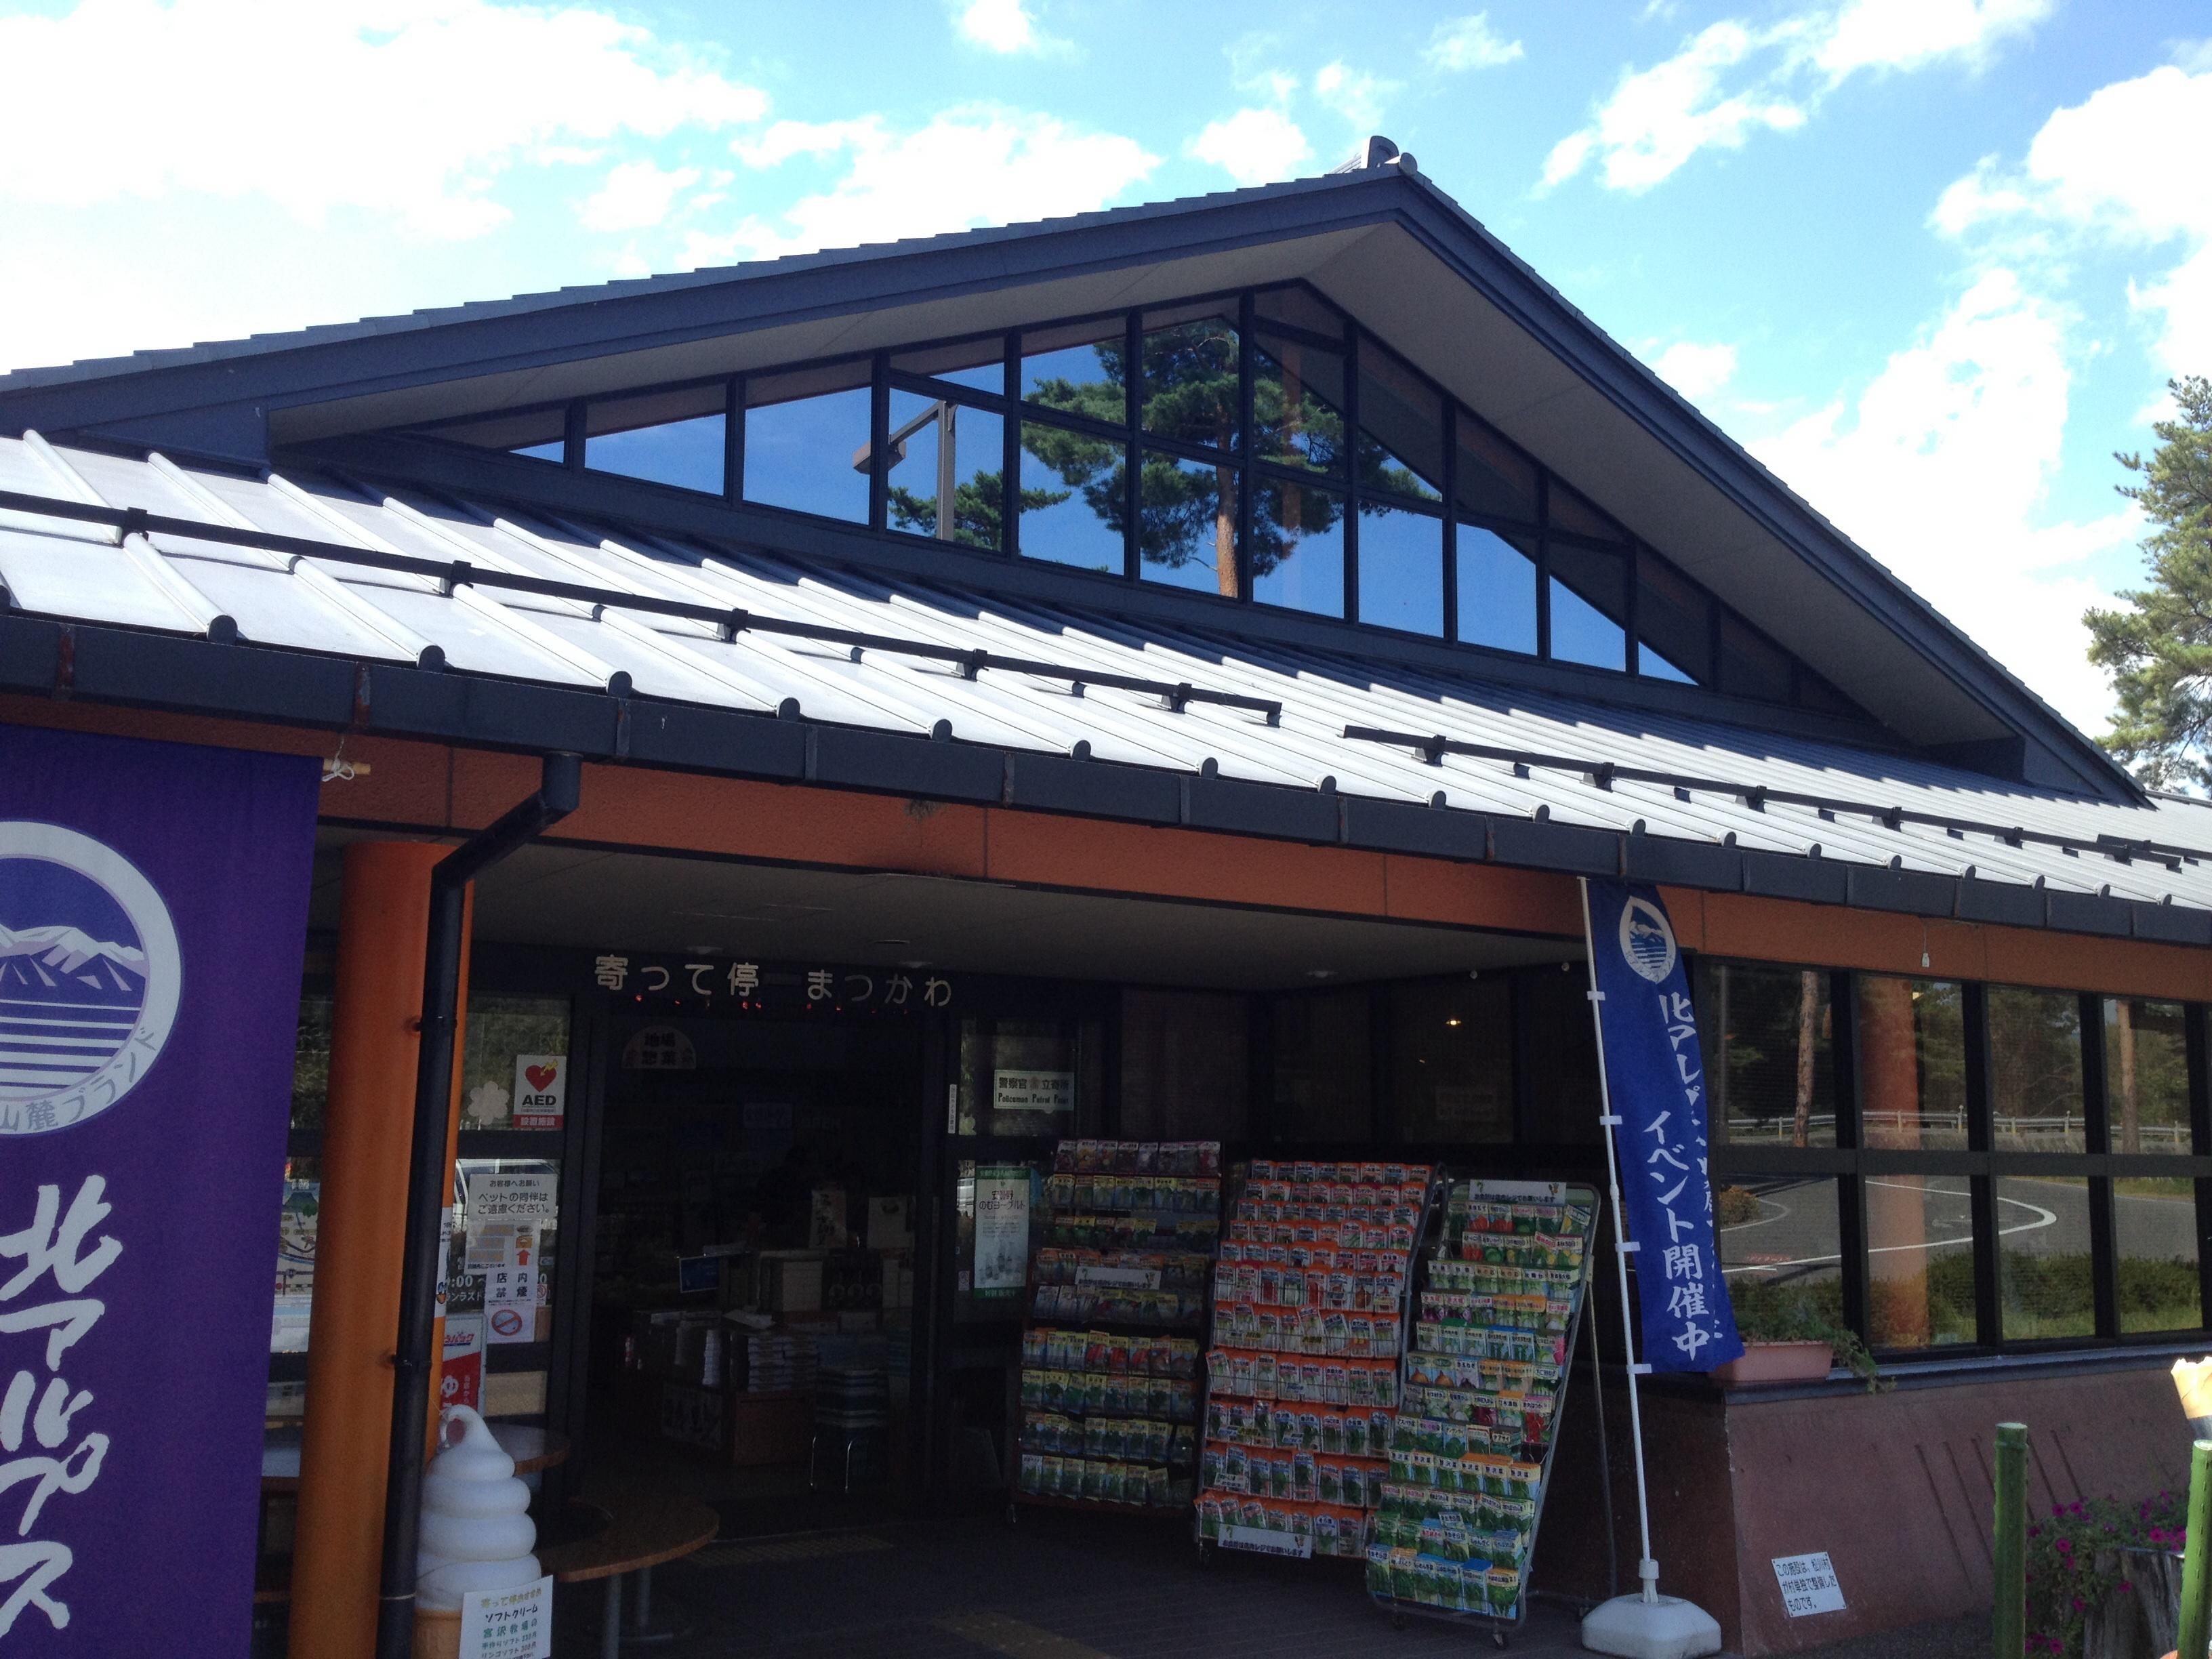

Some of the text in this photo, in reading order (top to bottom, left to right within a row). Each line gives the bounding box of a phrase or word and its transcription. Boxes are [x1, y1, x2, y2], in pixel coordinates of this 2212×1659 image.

[595, 954, 952, 1007] 寄って停 まつかわ
[999, 1077, 1027, 1090] 警察官
[522, 1094, 557, 1106] AED
[478, 1192, 548, 1202] ペットの同伴は
[478, 1204, 550, 1214] ご遠慮ください。
[979, 1200, 1026, 1211] のむヨーグルト
[1643, 1110, 1711, 1361] イベント開催中
[1787, 1596, 1818, 1612] ものです。
[485, 1604, 538, 1623] ソフトクリーム
